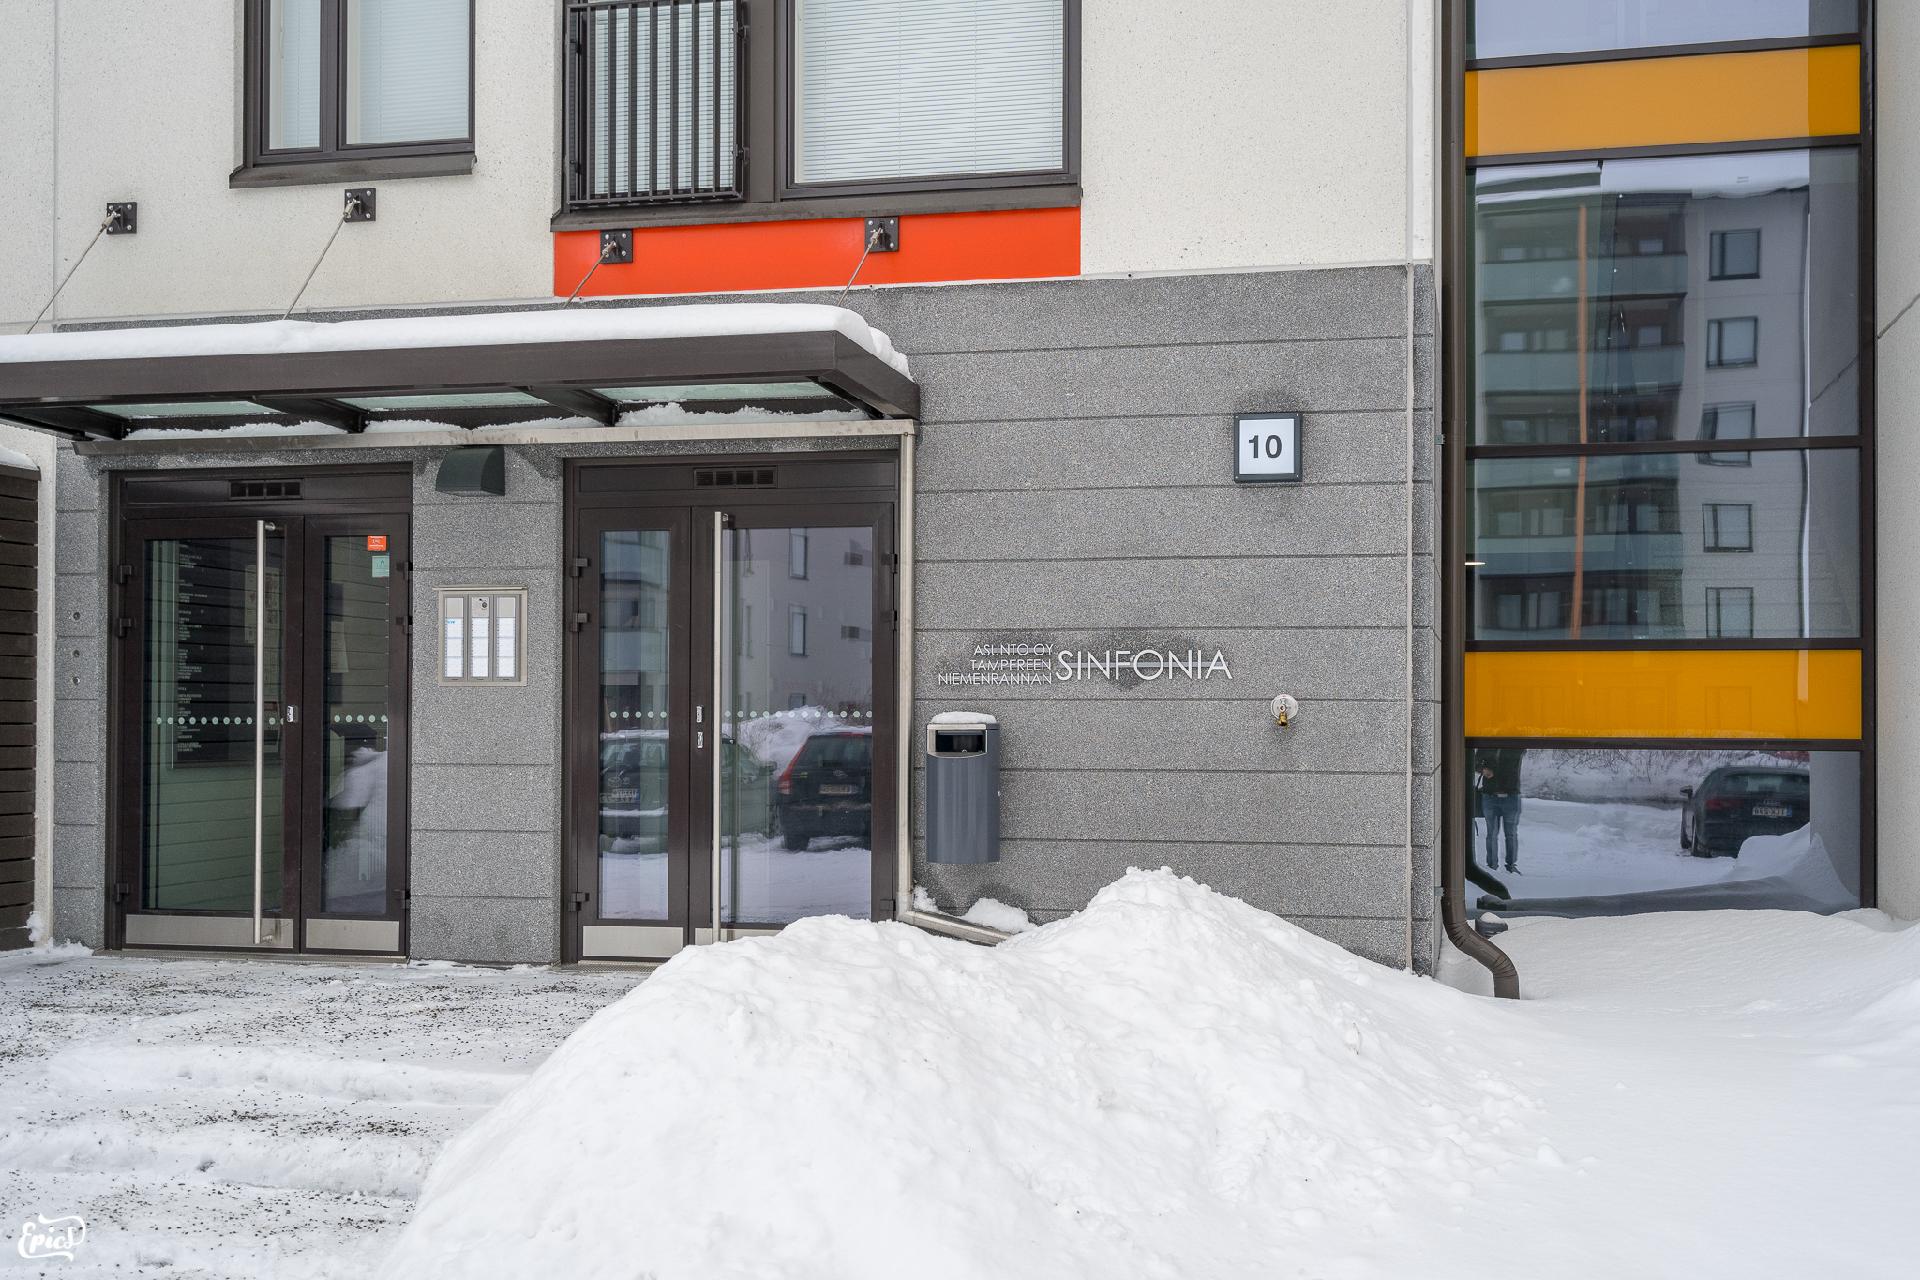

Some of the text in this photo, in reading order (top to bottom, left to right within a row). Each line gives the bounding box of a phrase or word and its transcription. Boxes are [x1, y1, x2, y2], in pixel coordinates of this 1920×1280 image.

[1248, 434, 1283, 459] 10
[1033, 643, 1054, 656] OY
[969, 658, 1052, 671] TAMPEREEN
[1055, 649, 1233, 681] SINFONIA
[938, 672, 1053, 685] NIEMENRANNAN
